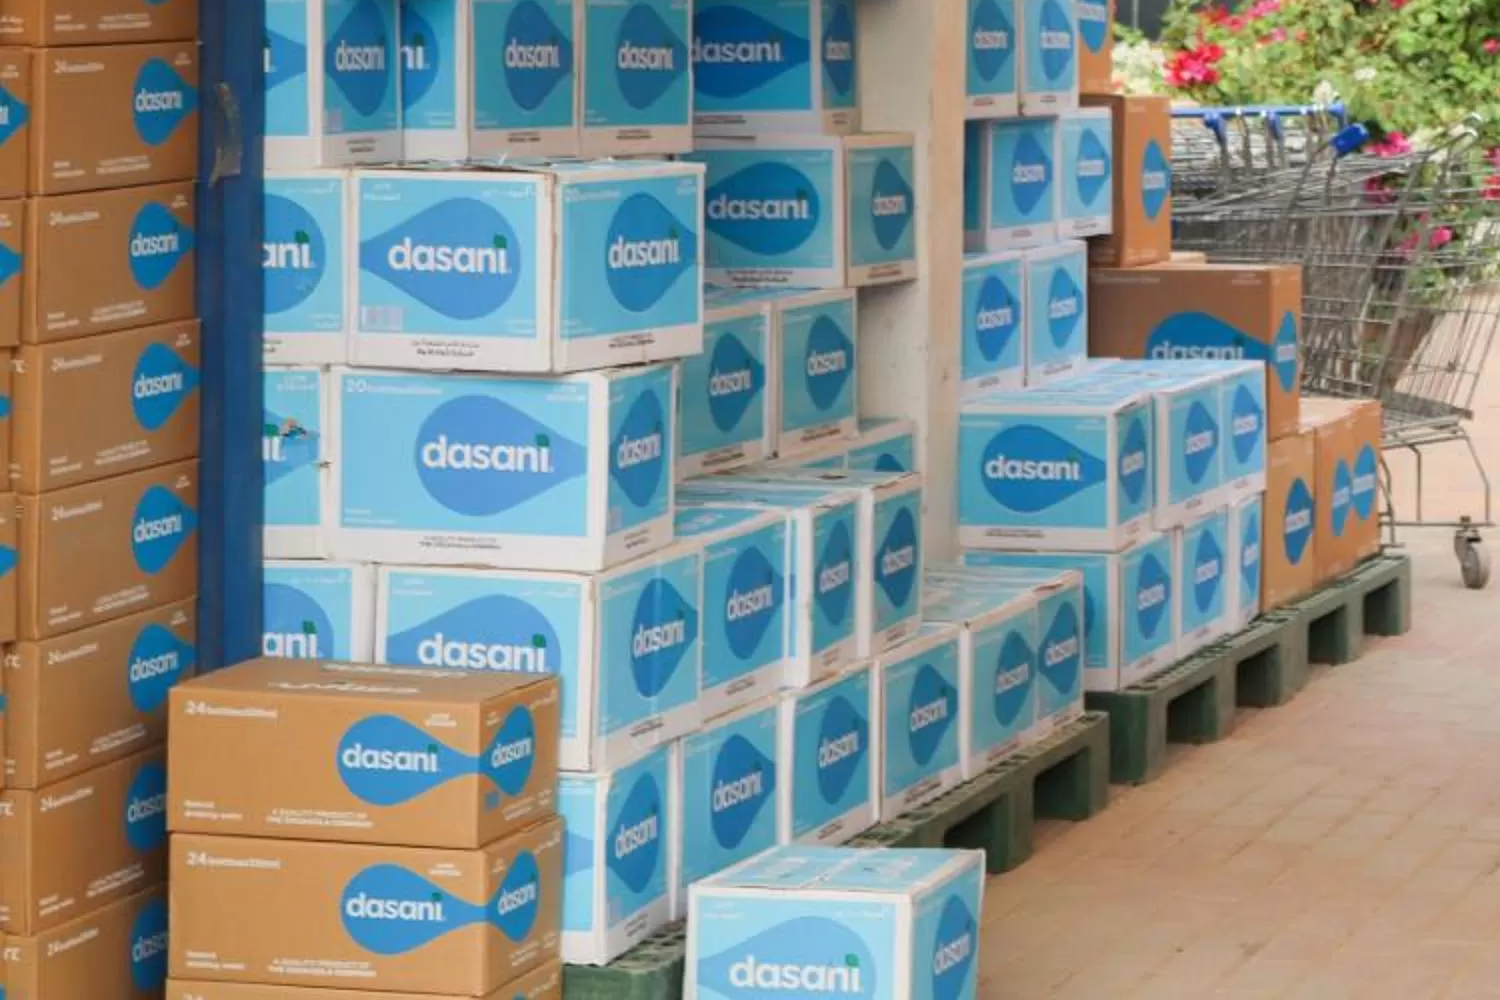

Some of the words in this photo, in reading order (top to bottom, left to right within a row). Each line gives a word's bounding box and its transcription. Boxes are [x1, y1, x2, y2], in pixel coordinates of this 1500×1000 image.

[336, 40, 385, 72] dasani
[505, 38, 560, 69] dasani
[618, 40, 674, 70] dasani
[135, 89, 182, 112] dasani
[708, 192, 812, 220] dasani
[131, 232, 179, 257] dasani
[262, 234, 315, 269] ani
[387, 236, 511, 274] dasani
[608, 234, 680, 269] dasani
[134, 372, 182, 398] dasani
[421, 434, 553, 473] dasani
[617, 432, 661, 469] dasani
[985, 454, 1082, 482] dasani
[134, 514, 182, 542] dasani
[727, 583, 773, 621] dasani
[263, 622, 323, 659] ani
[633, 612, 685, 657] dasani
[130, 652, 178, 682] dasani
[418, 631, 552, 673] dasani
[186, 701, 207, 715] 24
[342, 741, 440, 773] dasani
[491, 735, 531, 769] dasani
[818, 732, 859, 767] dasani
[713, 769, 763, 811] dasani
[615, 812, 657, 858] dasani
[187, 852, 207, 866] 24
[346, 891, 445, 921] dasani
[498, 880, 535, 915] dasani
[729, 954, 863, 993] dasani
